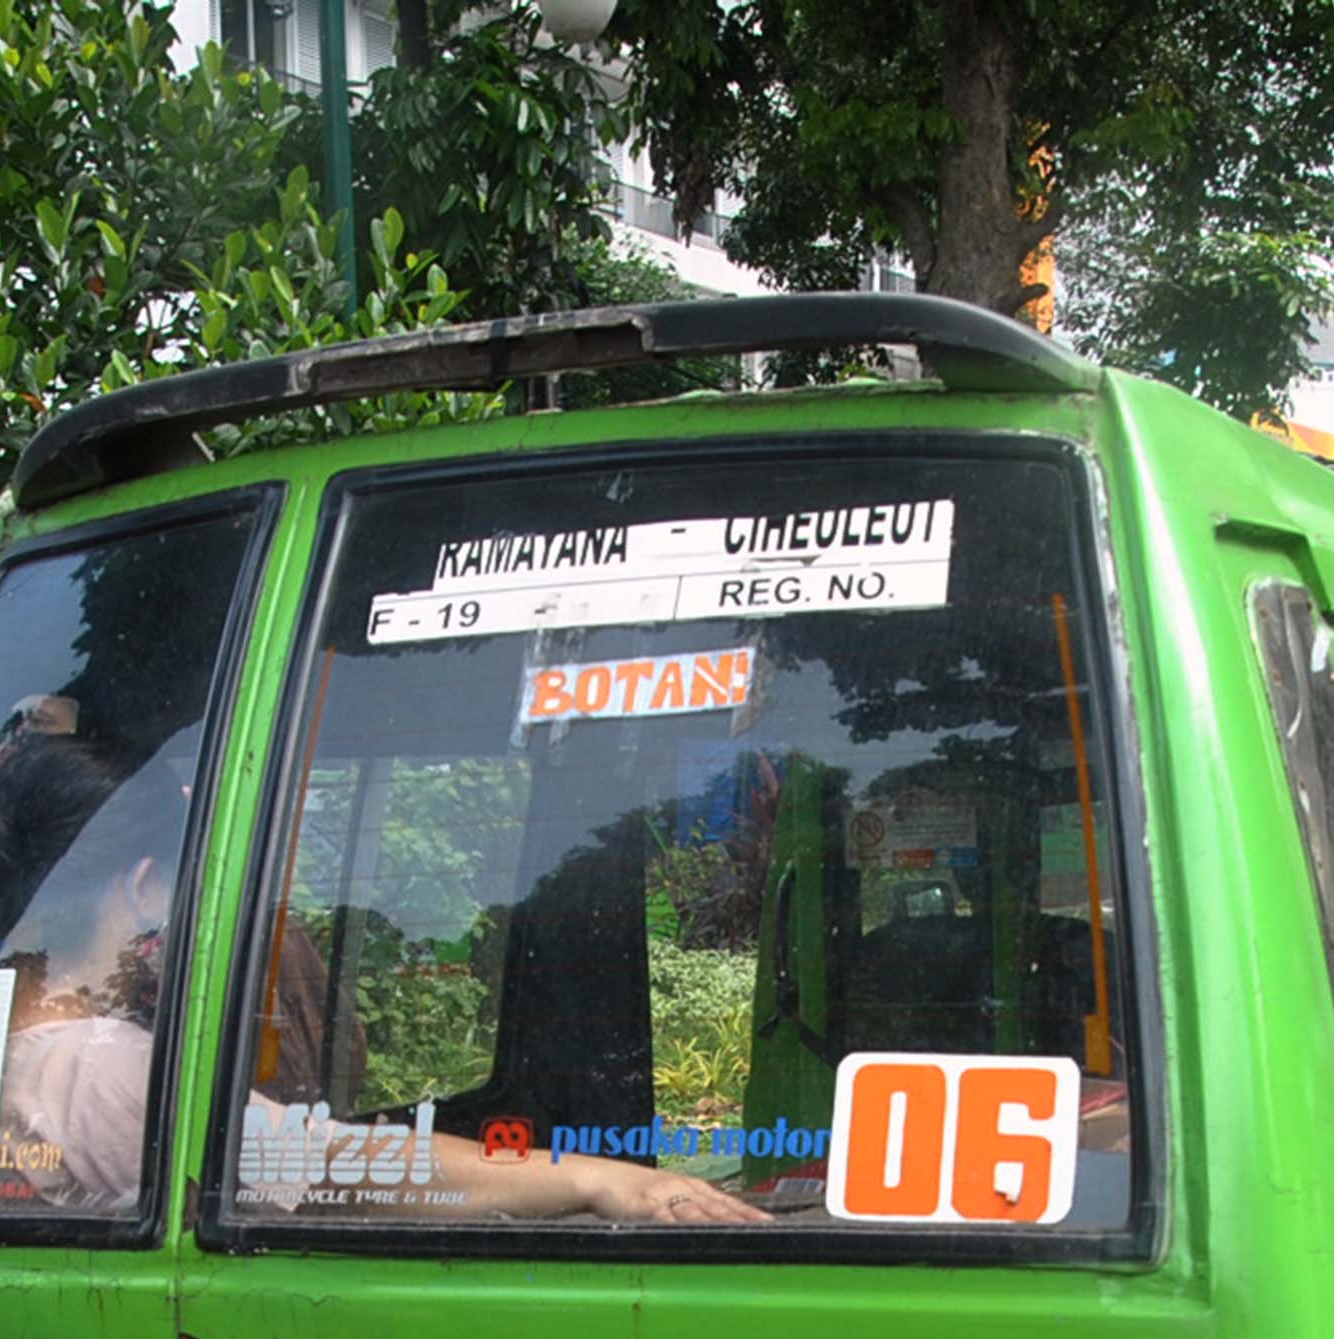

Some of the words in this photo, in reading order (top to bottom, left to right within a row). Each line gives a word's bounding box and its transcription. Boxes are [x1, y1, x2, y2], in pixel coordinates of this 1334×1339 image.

[719, 576, 811, 607] REG.
[827, 572, 895, 601] NO.
[370, 607, 395, 636] F
[436, 600, 481, 630] 19
[239, 1101, 442, 1185] Mizzl
[551, 1115, 700, 1165] pusaka
[713, 1116, 833, 1159] motor
[844, 1063, 1058, 1222] 06
